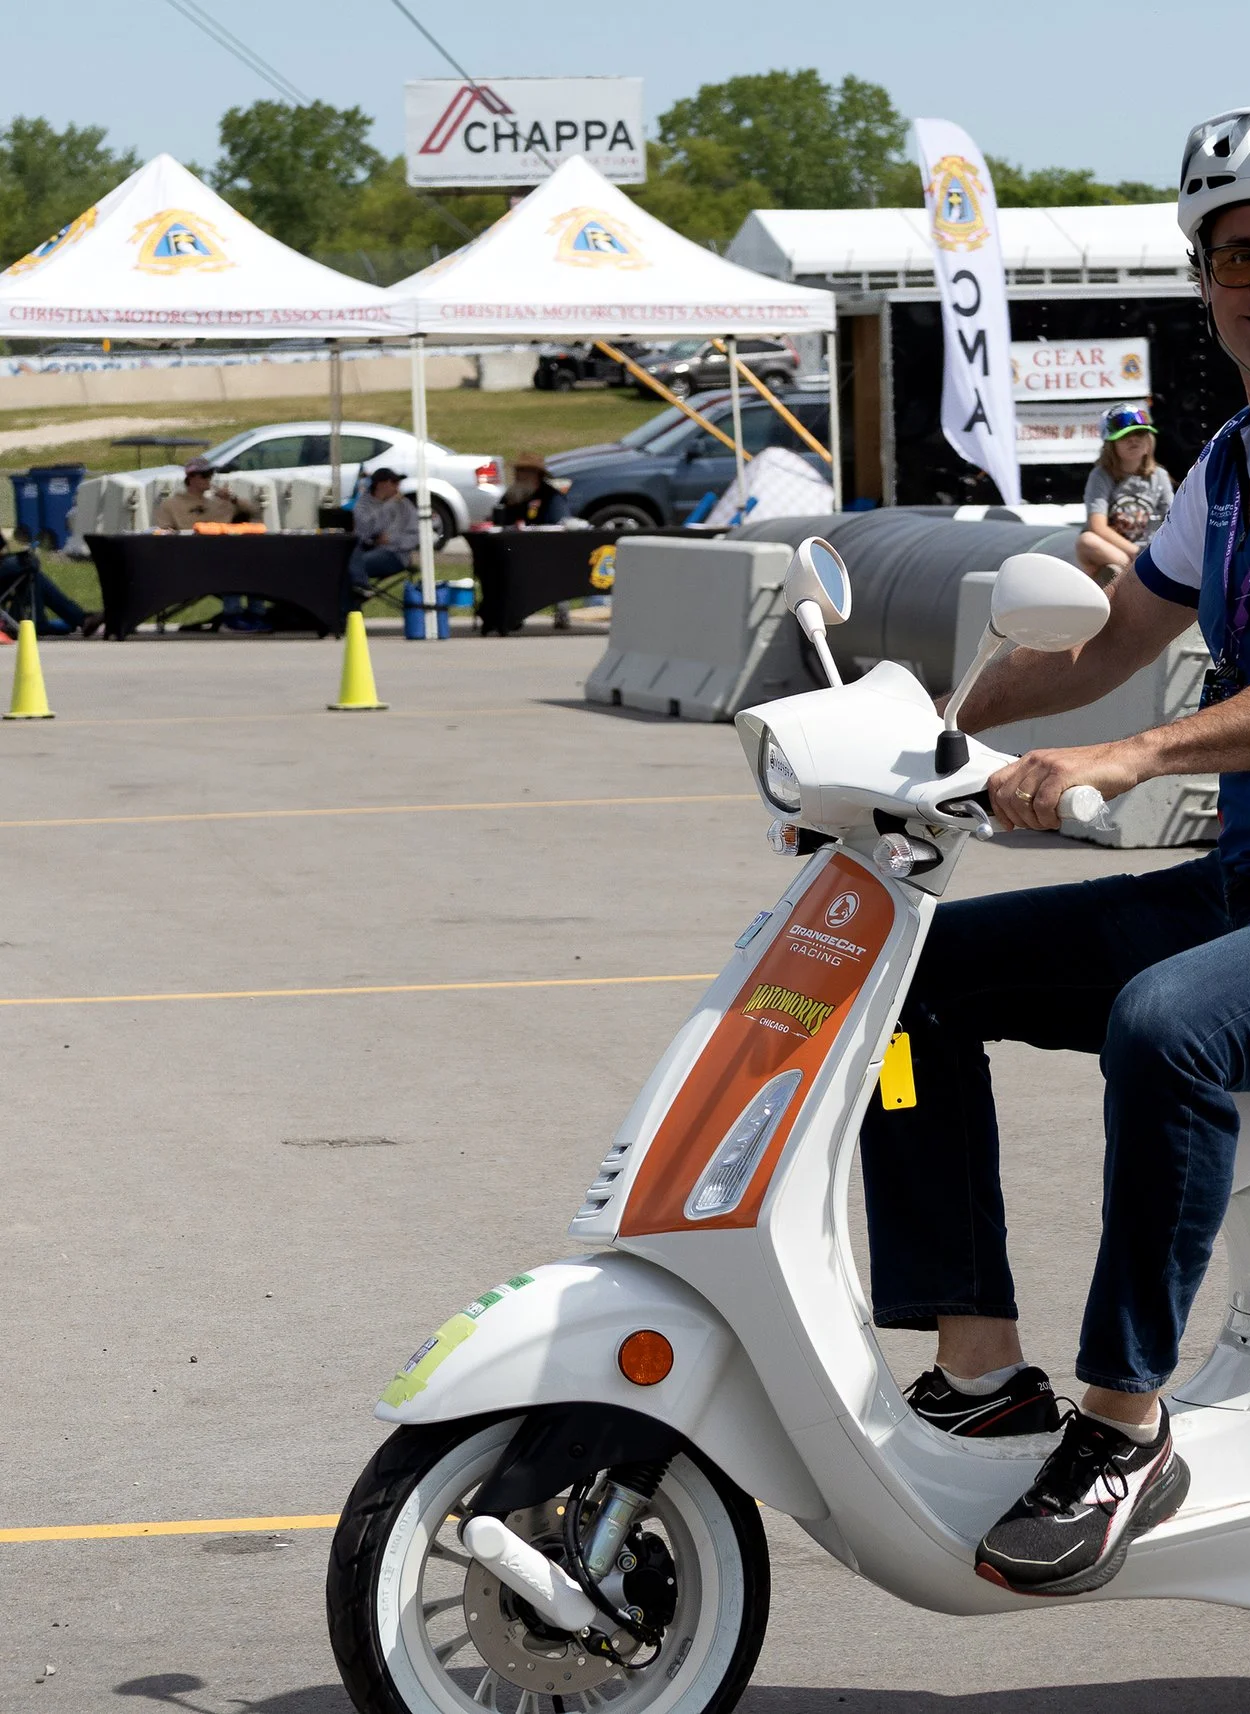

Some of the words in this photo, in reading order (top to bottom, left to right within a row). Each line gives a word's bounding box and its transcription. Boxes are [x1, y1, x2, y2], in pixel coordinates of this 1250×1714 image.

[463, 119, 635, 153] CHAPPA
[9, 306, 108, 323] CHRISTIAN
[114, 308, 265, 324] MOTORCYCLISTS
[269, 305, 392, 323] ASSOCIATION
[439, 304, 536, 320] CHRISTIAN
[542, 304, 686, 321] MOTORCYCLISTS
[691, 304, 810, 320] ASSOCIATION
[1032, 347, 1106, 368] GEAR
[1024, 369, 1115, 391] CHECK
[788, 924, 867, 956] ORANGECAT
[790, 943, 842, 967] RACING
[741, 983, 836, 1037] MOTOWORKS
[759, 1017, 790, 1034] CHICAGO
